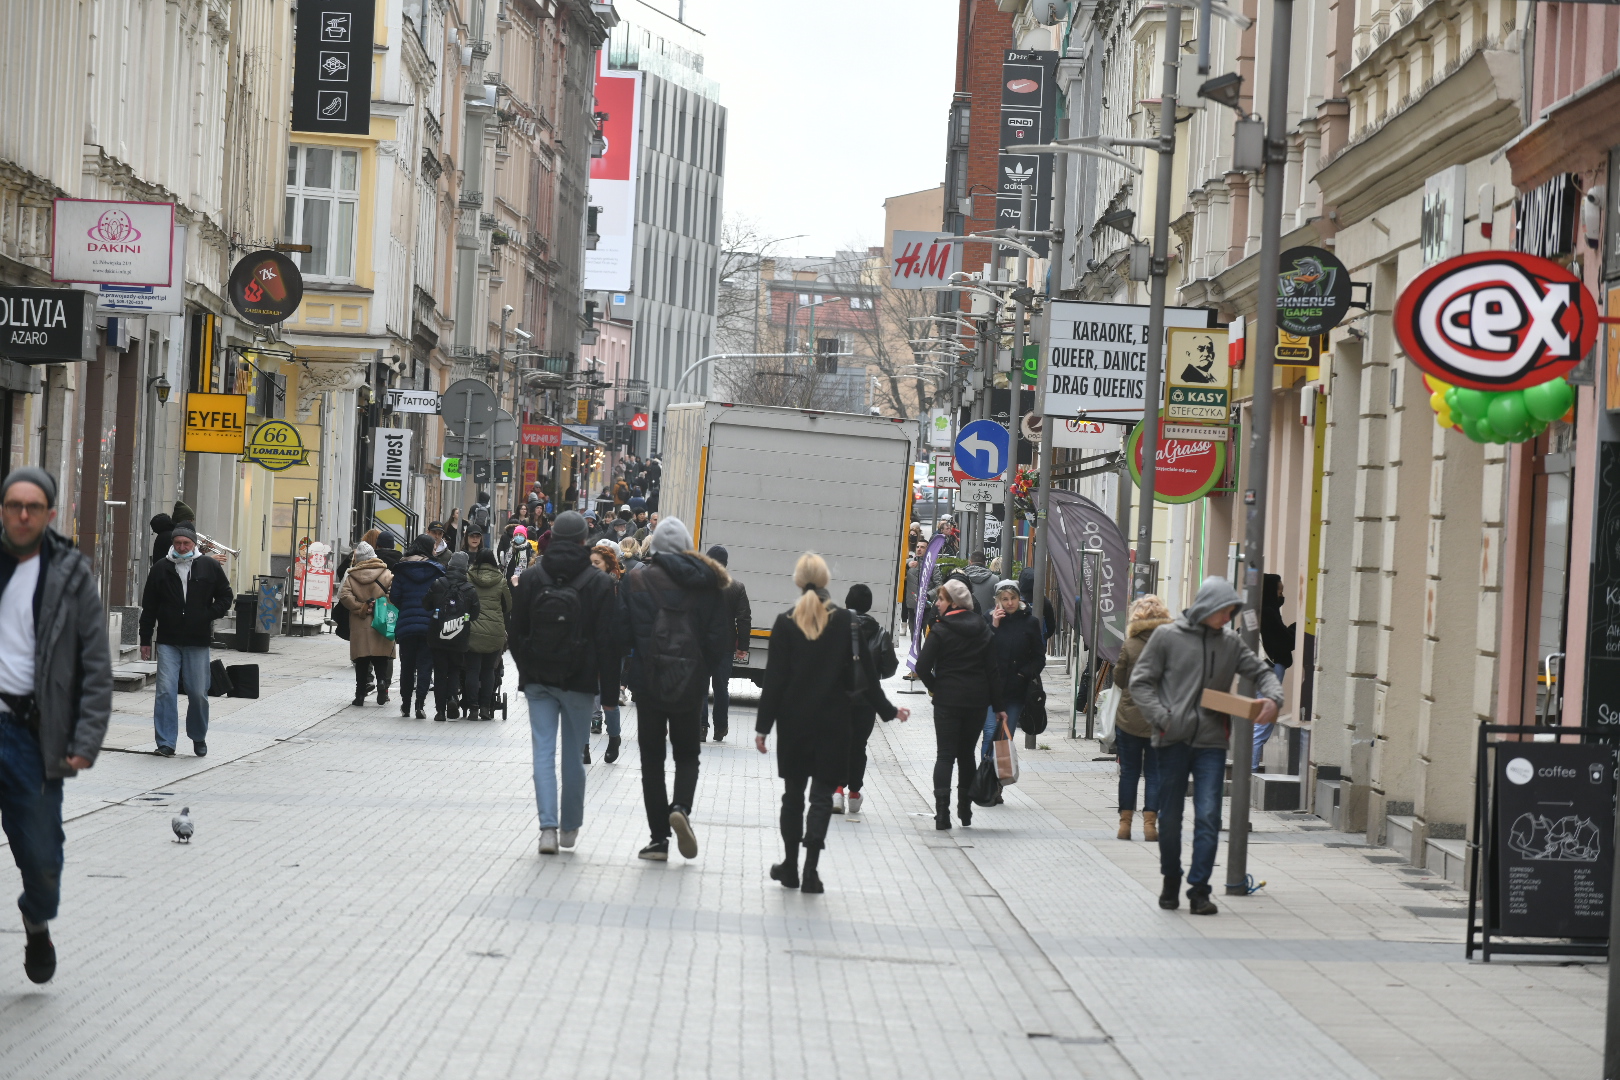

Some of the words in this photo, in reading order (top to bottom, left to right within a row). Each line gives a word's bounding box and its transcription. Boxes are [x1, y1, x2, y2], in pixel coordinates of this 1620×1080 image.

[87, 243, 141, 254] DAKINI
[895, 242, 951, 281] H&M
[1276, 296, 1336, 307] SKNERUS
[1286, 308, 1323, 317] GAMES
[10, 331, 48, 345] AZARO
[1072, 321, 1136, 345] KARAOKE,
[1052, 347, 1098, 371] QUEER,
[1103, 351, 1146, 372] DANCE
[1052, 375, 1089, 395] DRAG
[1093, 377, 1144, 398] QUEENS
[403, 397, 436, 407] TATTOO
[1188, 391, 1224, 403] KASY
[1171, 406, 1224, 418] STEFCZYKA
[187, 411, 242, 429] EYFEL
[263, 428, 288, 443] 66
[1166, 427, 1226, 435] UBEZPIECZENIA
[523, 433, 559, 444] VENUS
[253, 448, 300, 456] LOMBARD
[381, 434, 404, 477] invest
[443, 615, 465, 634] NIKE
[1538, 765, 1577, 778] coffee
